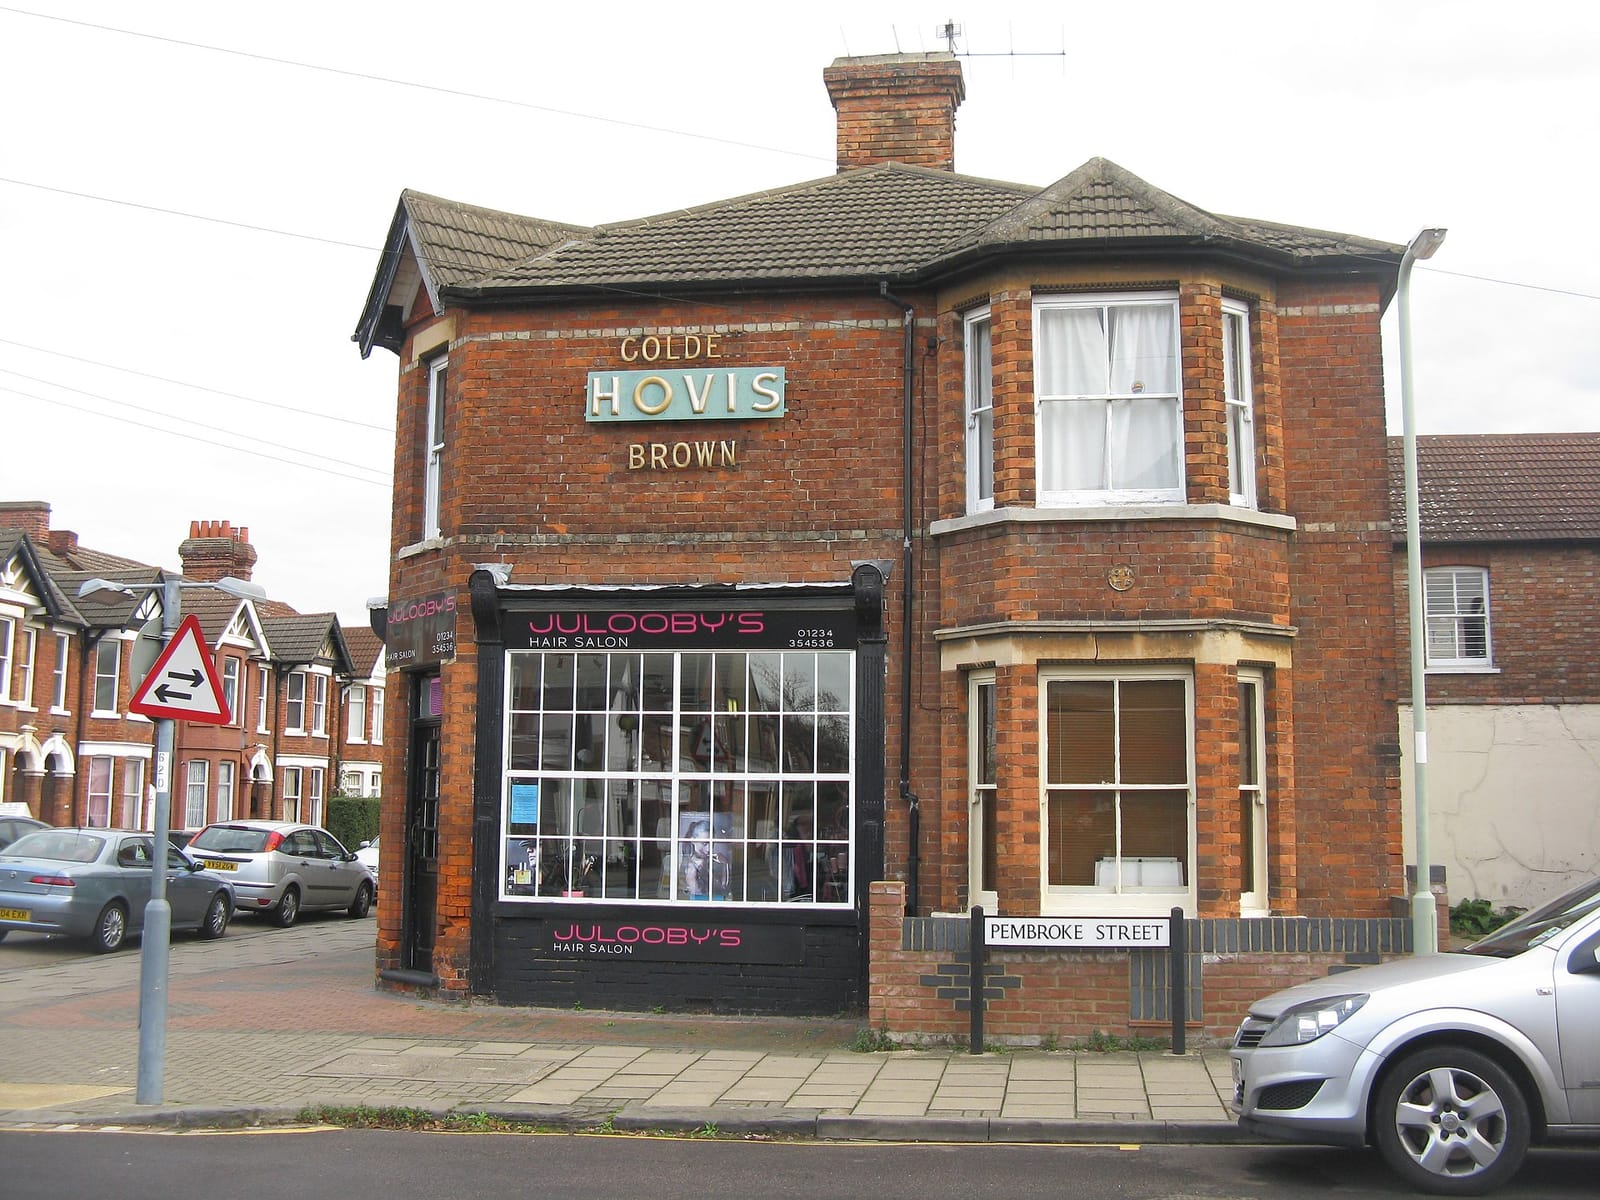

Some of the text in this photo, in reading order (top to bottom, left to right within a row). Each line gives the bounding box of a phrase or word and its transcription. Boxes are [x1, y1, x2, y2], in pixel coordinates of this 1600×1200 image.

[591, 372, 780, 416] HOVIS
[628, 440, 736, 470] BROWN
[387, 595, 455, 624] JULOOBY'S
[529, 612, 765, 634] JULOOBY'S
[436, 631, 453, 641] 01234
[797, 629, 833, 638] 01234
[529, 636, 628, 648] HAIR SALON
[788, 639, 834, 648] 354536
[399, 649, 416, 660] SALON
[553, 924, 742, 946] JULOOBY'S
[991, 923, 1163, 941] PEMBROKE STREET
[553, 942, 633, 954] HAIR SALON
